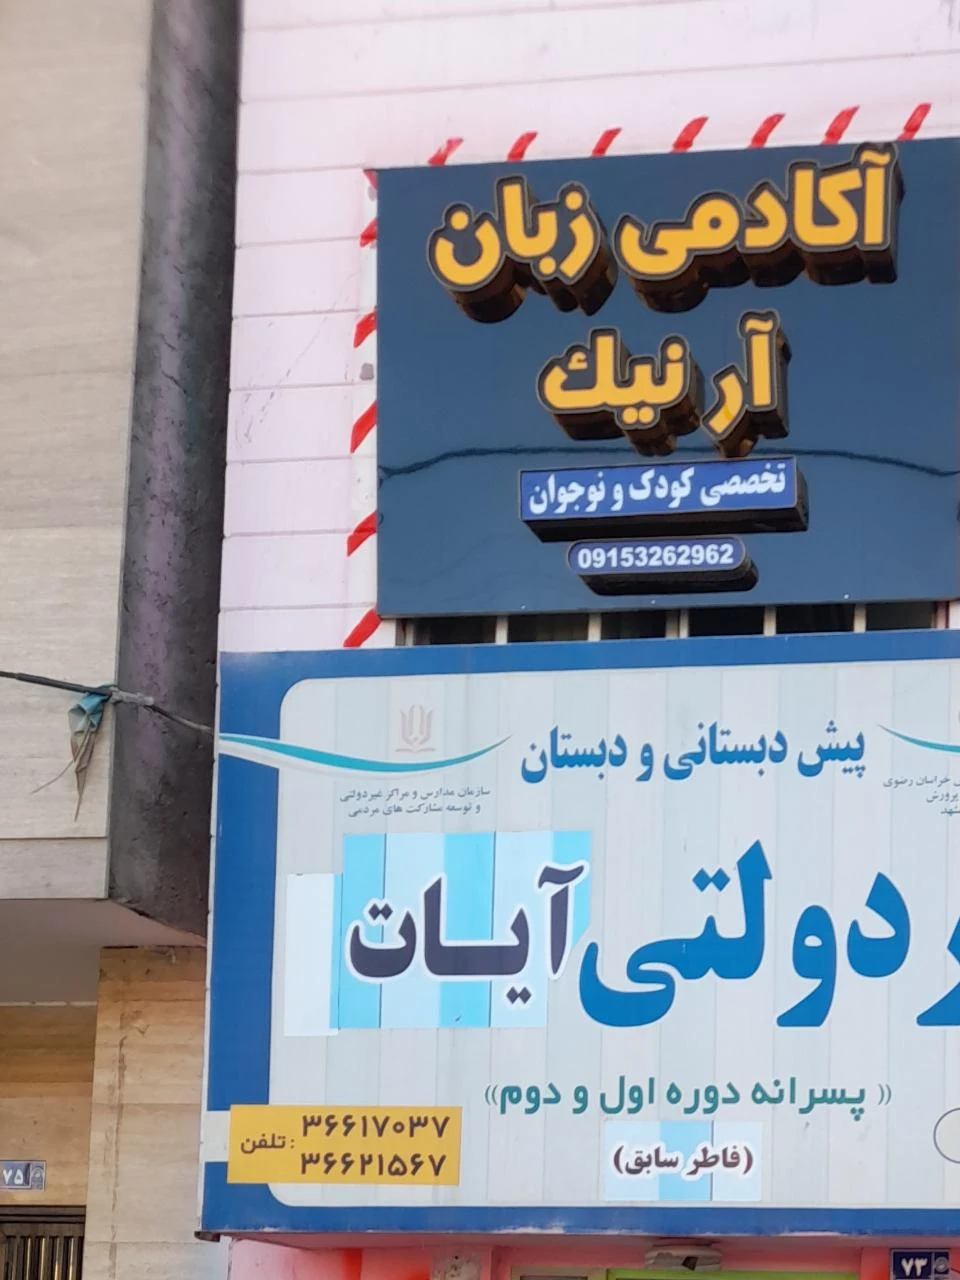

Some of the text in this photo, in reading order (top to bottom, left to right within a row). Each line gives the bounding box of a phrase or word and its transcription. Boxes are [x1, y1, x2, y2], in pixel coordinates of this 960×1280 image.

[434, 151, 892, 287] آکادمی زبان
[707, 317, 775, 436] آر
[529, 462, 786, 515] تخصصی کودک و نوجوان
[577, 543, 735, 569] 09153262962
[520, 719, 866, 784] پیش دبستانی و دبستان
[420, 788, 455, 800] مدارس
[457, 786, 491, 799] سازمان
[882, 776, 914, 789] رضوی
[916, 775, 950, 788] خراسان
[386, 788, 409, 802] مراکز
[926, 790, 958, 803] پرورش
[348, 806, 379, 818] مردمی
[445, 802, 473, 815] توسعه
[349, 864, 585, 1005] آیات
[573, 1088, 589, 1115] و
[599, 1075, 655, 1115] اول
[666, 1081, 741, 1115] دوره
[751, 1077, 866, 1121] پسرانه
[302, 1114, 450, 1138] ۳۶۶۱۷۰۳۷
[300, 1152, 447, 1177] ۳۶۶۲۱۵۶۷
[901, 1257, 928, 1277] ۷۳
